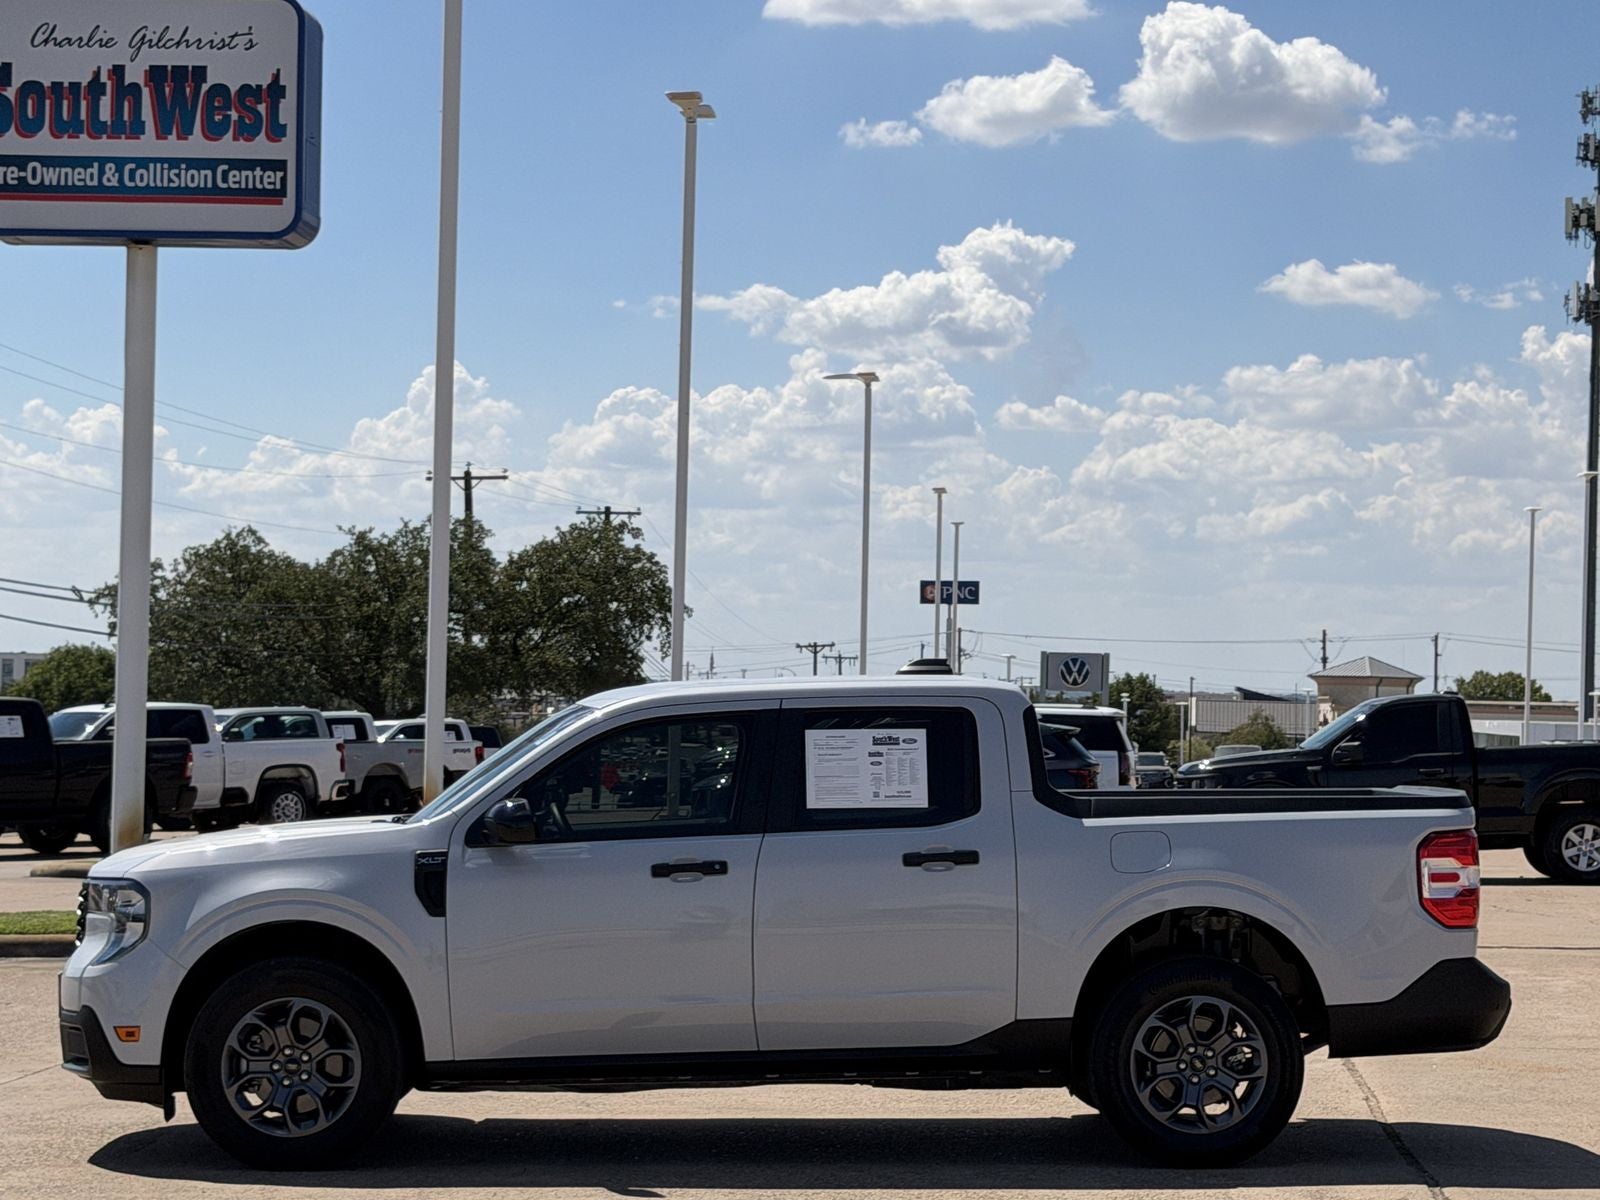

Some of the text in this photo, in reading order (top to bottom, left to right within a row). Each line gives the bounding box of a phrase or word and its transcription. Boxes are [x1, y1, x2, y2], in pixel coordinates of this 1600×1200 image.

[30, 22, 258, 62] Charlie Gilchrist's
[0, 161, 284, 190] re-Owned & Collision Center
[942, 586, 976, 600] PNC
[417, 856, 447, 865] XLT
